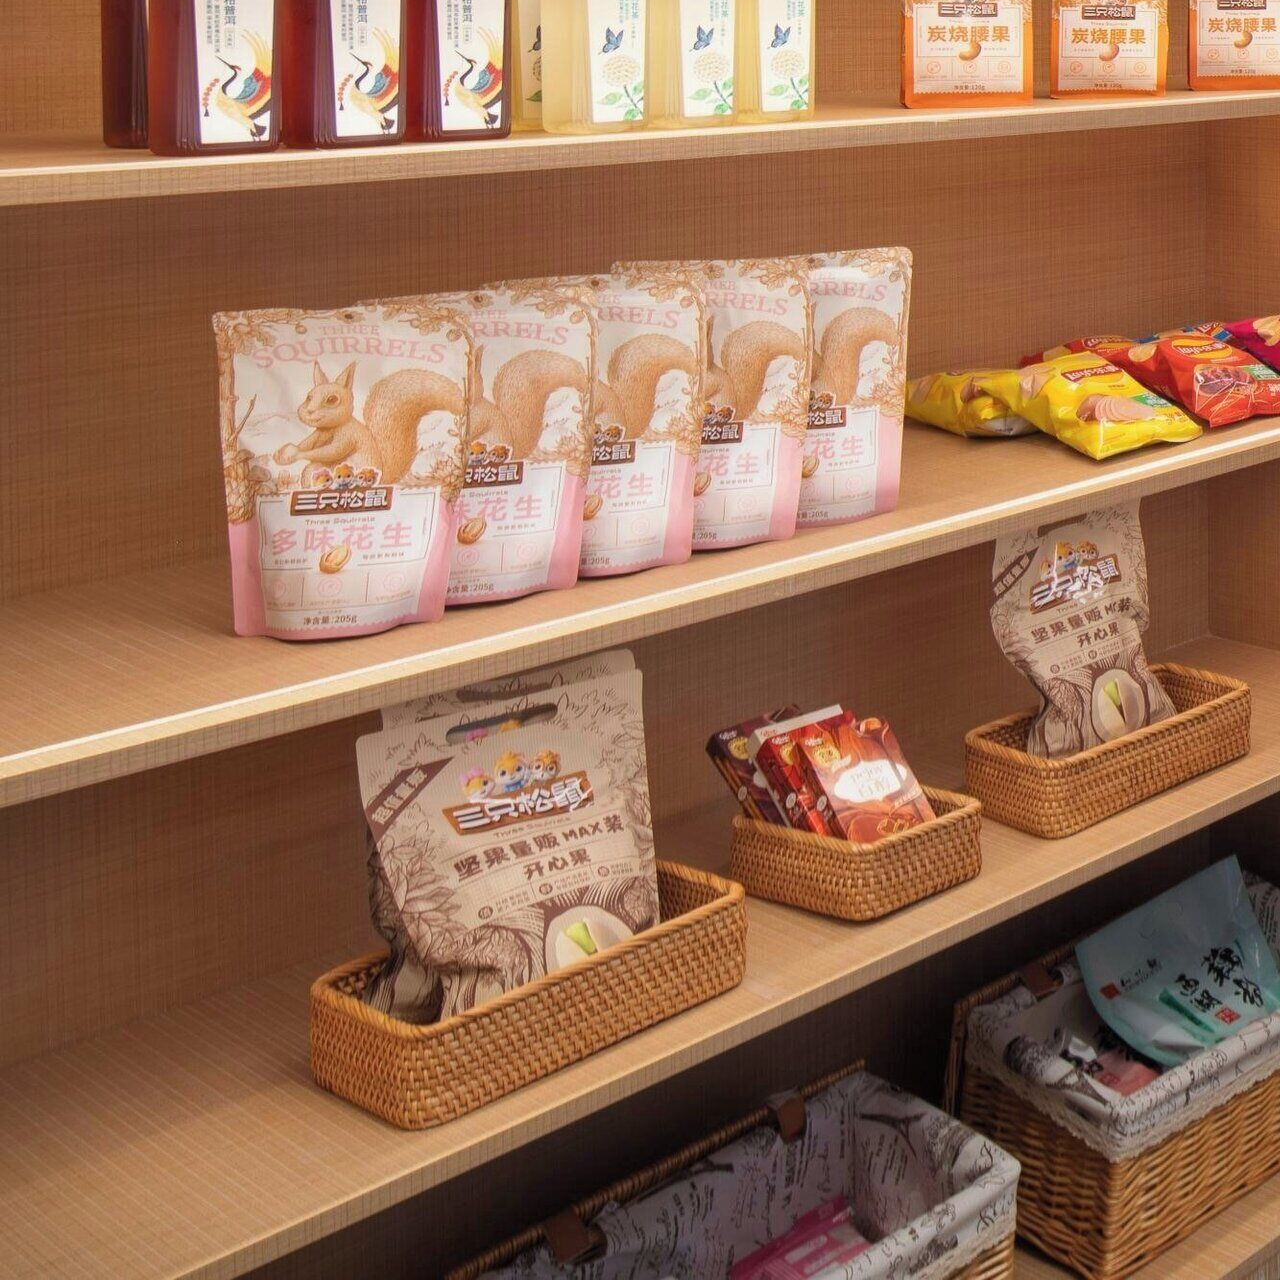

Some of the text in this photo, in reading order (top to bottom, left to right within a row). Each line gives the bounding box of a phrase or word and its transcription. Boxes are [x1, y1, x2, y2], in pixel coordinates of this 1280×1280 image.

[940, 3, 996, 16] 三只松鼠
[1083, 7, 1135, 19] 三只松鼠
[928, 25, 1010, 43] 炭烧腰果
[1208, 18, 1277, 33] 炭烧腰果
[1072, 28, 1146, 44] 炭烧腰果
[319, 324, 379, 336] THREE
[472, 322, 569, 345] RRELS
[251, 336, 448, 369] SQUIRRELS
[807, 410, 843, 426] 松鼠
[702, 425, 741, 441] 松鼠
[592, 444, 632, 462] 松鼠
[811, 436, 864, 460] 花生
[704, 453, 759, 476] 花生
[595, 473, 653, 499] 花生
[295, 489, 388, 511] 三只松鼠
[272, 523, 412, 556] 多味花生
[452, 777, 593, 830] 三只松鼠
[524, 848, 591, 881] 开心果
